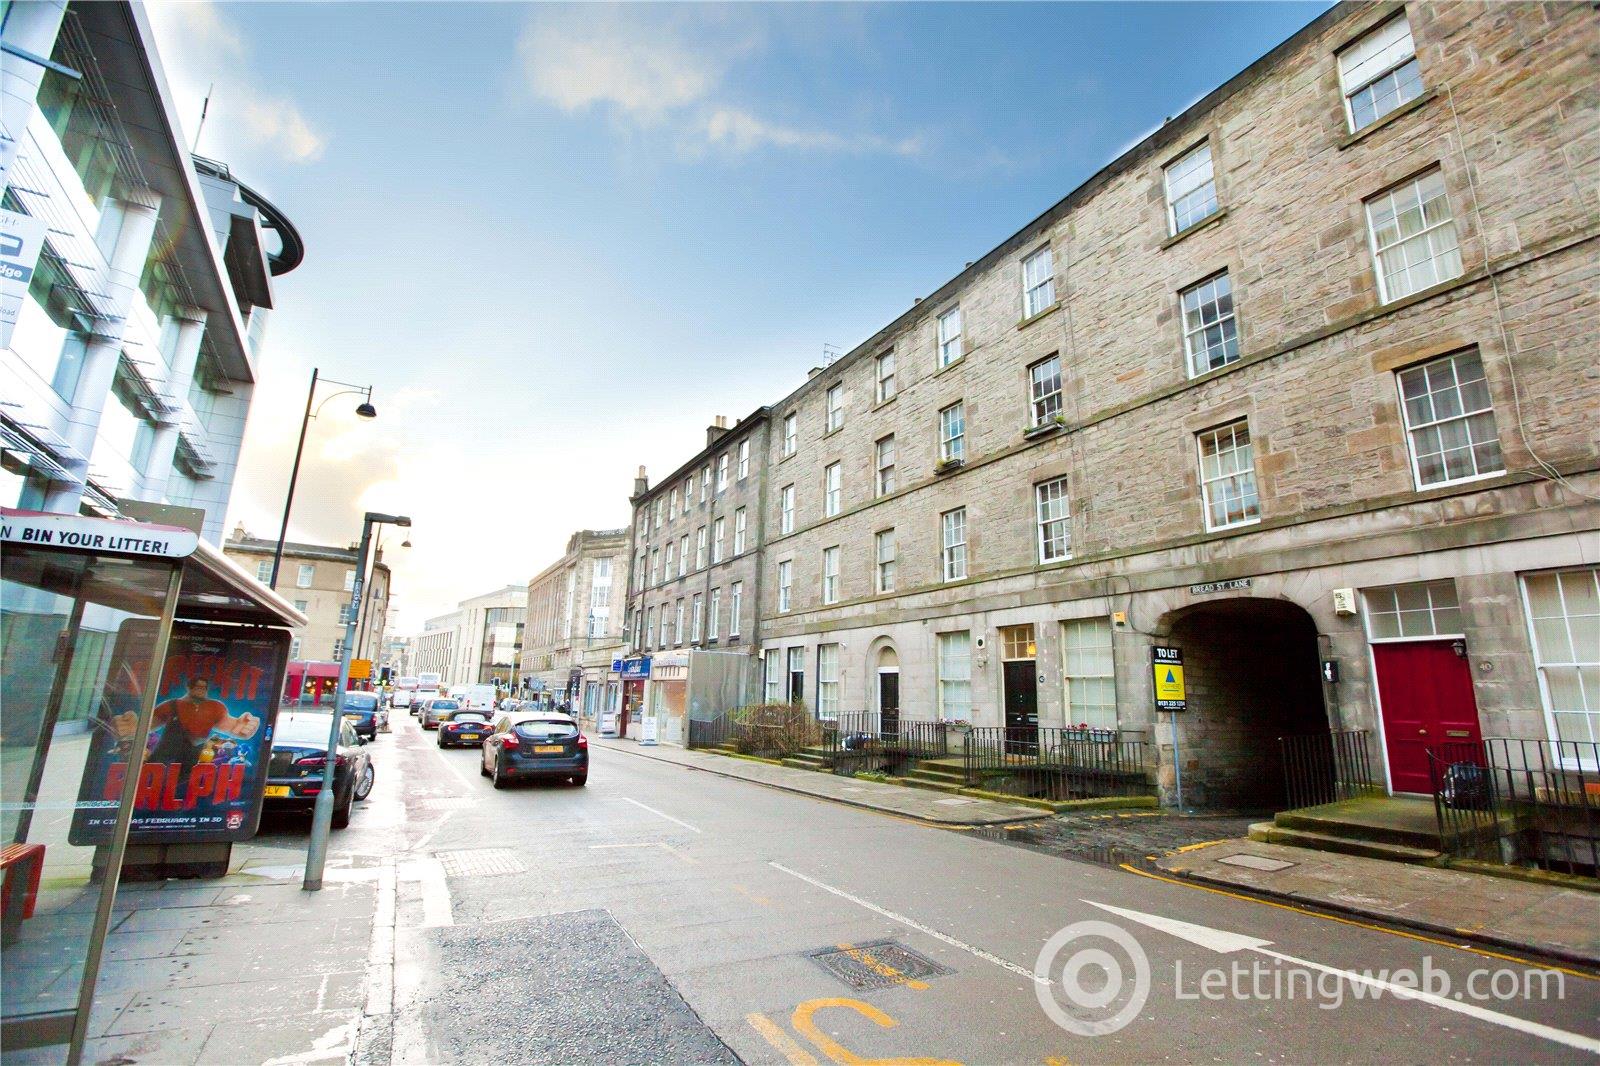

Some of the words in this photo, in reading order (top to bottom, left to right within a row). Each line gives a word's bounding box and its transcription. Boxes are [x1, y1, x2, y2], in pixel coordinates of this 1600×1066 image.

[22, 527, 53, 542] BIN
[59, 531, 103, 548] YOUR
[108, 536, 169, 554] LITTER!
[1193, 585, 1214, 594] BREAD
[1230, 579, 1249, 589] LANE
[1156, 647, 1167, 658] TO
[1166, 648, 1178, 659] LET
[1479, 663, 1492, 672] 40
[103, 763, 246, 812] RALPH
[145, 816, 190, 825] FEBRUARY
